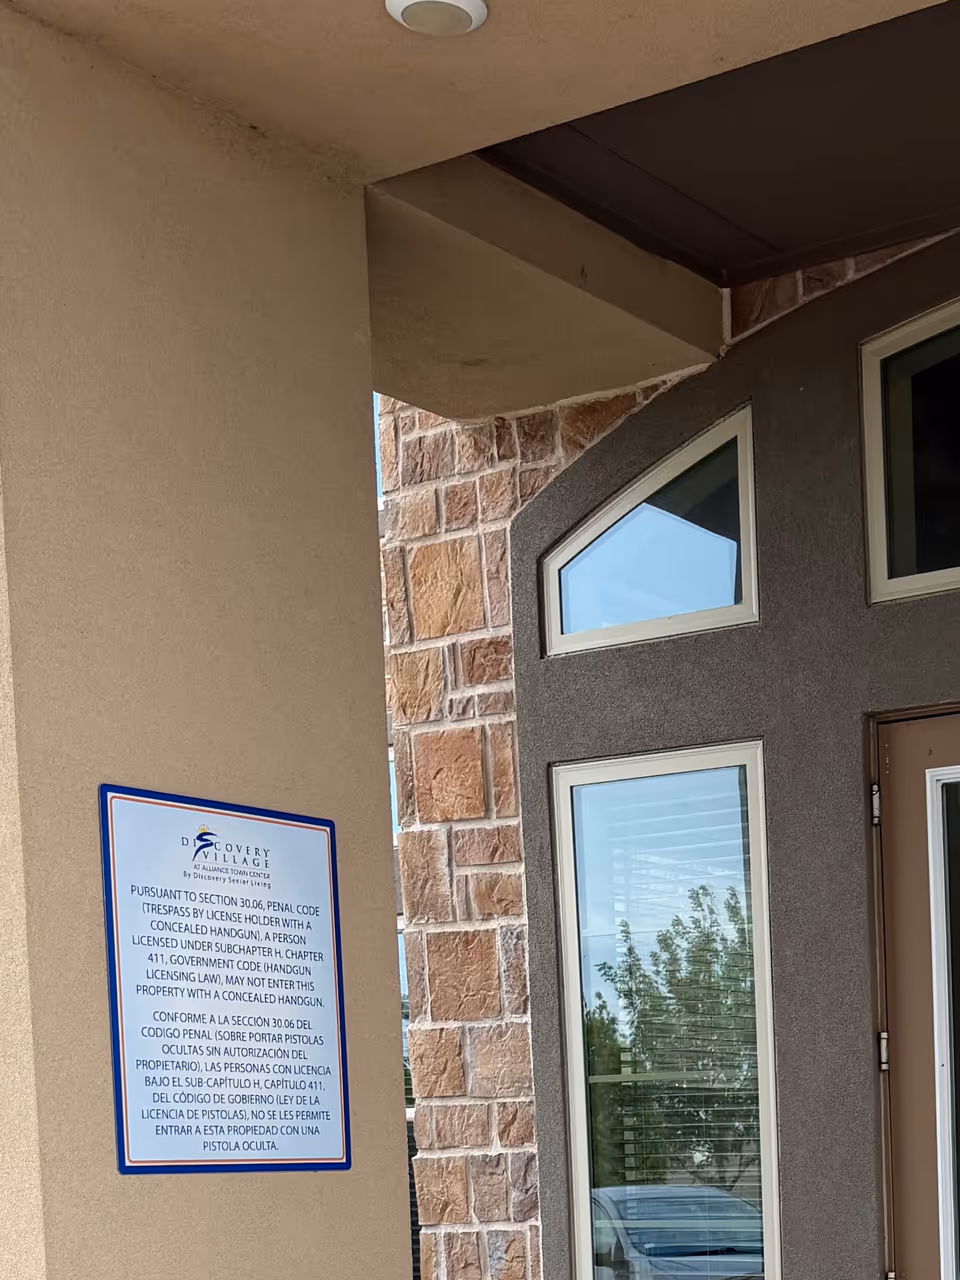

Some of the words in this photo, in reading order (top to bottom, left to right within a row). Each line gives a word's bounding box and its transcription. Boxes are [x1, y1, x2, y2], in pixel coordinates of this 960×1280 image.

[182, 832, 270, 861] DISCOVERY
[203, 851, 269, 868] VILLAGE
[193, 872, 226, 883] Discovery
[130, 884, 182, 901] PURSUANT
[183, 890, 197, 902] TO
[198, 892, 237, 907] SECTION
[239, 897, 265, 911] 30.06,
[266, 900, 294, 913] PENAL
[296, 904, 319, 916] CODE
[142, 901, 190, 918] (TRESPASS
[192, 907, 204, 921] BY
[206, 909, 242, 923] LICENSE
[244, 913, 280, 927] HOLDER
[281, 917, 303, 930] WITH
[305, 920, 311, 930] A
[150, 919, 208, 935] CONCEALED
[264, 931, 271, 941] A
[272, 931, 306, 945] PERSON
[132, 934, 178, 949] LICENSED
[180, 938, 213, 952] UNDER
[214, 941, 272, 957] SUBCHAPTER
[284, 948, 323, 962] CHAPTER
[169, 953, 234, 969] GOVERNMENT
[236, 959, 262, 972] CODE
[263, 961, 311, 978] (HANDGUN
[146, 968, 196, 983] LICENSING
[197, 972, 223, 986] LAW),
[225, 974, 245, 986] MAY
[246, 976, 266, 988] NOT
[267, 977, 294, 990] ENTER
[295, 980, 314, 992] THIS
[136, 983, 185, 997] PROPERTY
[186, 987, 211, 999] WITH
[213, 989, 220, 1000] A
[221, 988, 276, 1004] CONCEALED
[277, 994, 324, 1007] HANDGUN.
[152, 1010, 207, 1024] CONFORME
[208, 1014, 216, 1024] A
[218, 1015, 229, 1025] LA
[271, 1017, 294, 1029] 30.06
[296, 1019, 312, 1030] DEL
[182, 1028, 212, 1040] PENAL
[214, 1029, 247, 1042] (SOBRE
[248, 1031, 283, 1044] PORTAR
[284, 1033, 324, 1046] PISTOLAS
[161, 1043, 204, 1056] OCULTAS
[205, 1045, 220, 1056] SIN
[222, 1044, 289, 1059] AUTORIZACIÓN
[291, 1049, 307, 1059] DEL
[135, 1058, 203, 1072] PROPIETARIO),
[204, 1061, 222, 1072] LAS
[223, 1062, 271, 1074] PERSONAS
[272, 1063, 291, 1074] CON
[293, 1064, 331, 1075] LICENCIA
[144, 1075, 169, 1086] BAJO
[171, 1076, 183, 1087] EL
[184, 1075, 251, 1088] SUB-CAPÍTULO
[263, 1077, 306, 1090] CAPÍTULO
[152, 1092, 171, 1103] DEL
[172, 1090, 211, 1103] CÓDIGO
[213, 1093, 225, 1104] DE
[227, 1093, 274, 1104] GOBIERNO
[275, 1094, 294, 1105] (LEY
[295, 1095, 307, 1105] DE
[309, 1095, 320, 1105] LA
[141, 1108, 184, 1119] LICENCIA
[186, 1109, 199, 1119] DE
[201, 1108, 249, 1121] PISTOLAS),
[251, 1109, 265, 1120] NO
[266, 1109, 276, 1120] SE
[278, 1110, 294, 1120] LES
[295, 1110, 330, 1120] PERMITE
[155, 1124, 192, 1135] ENTRAR
[194, 1125, 201, 1135] A
[203, 1125, 225, 1135] ESTA
[227, 1124, 278, 1135] PROPIEDAD
[279, 1125, 299, 1135] CON
[301, 1125, 320, 1135] UNA
[203, 1140, 240, 1151] PISTOLA
[241, 1140, 278, 1150] OCULTA.
